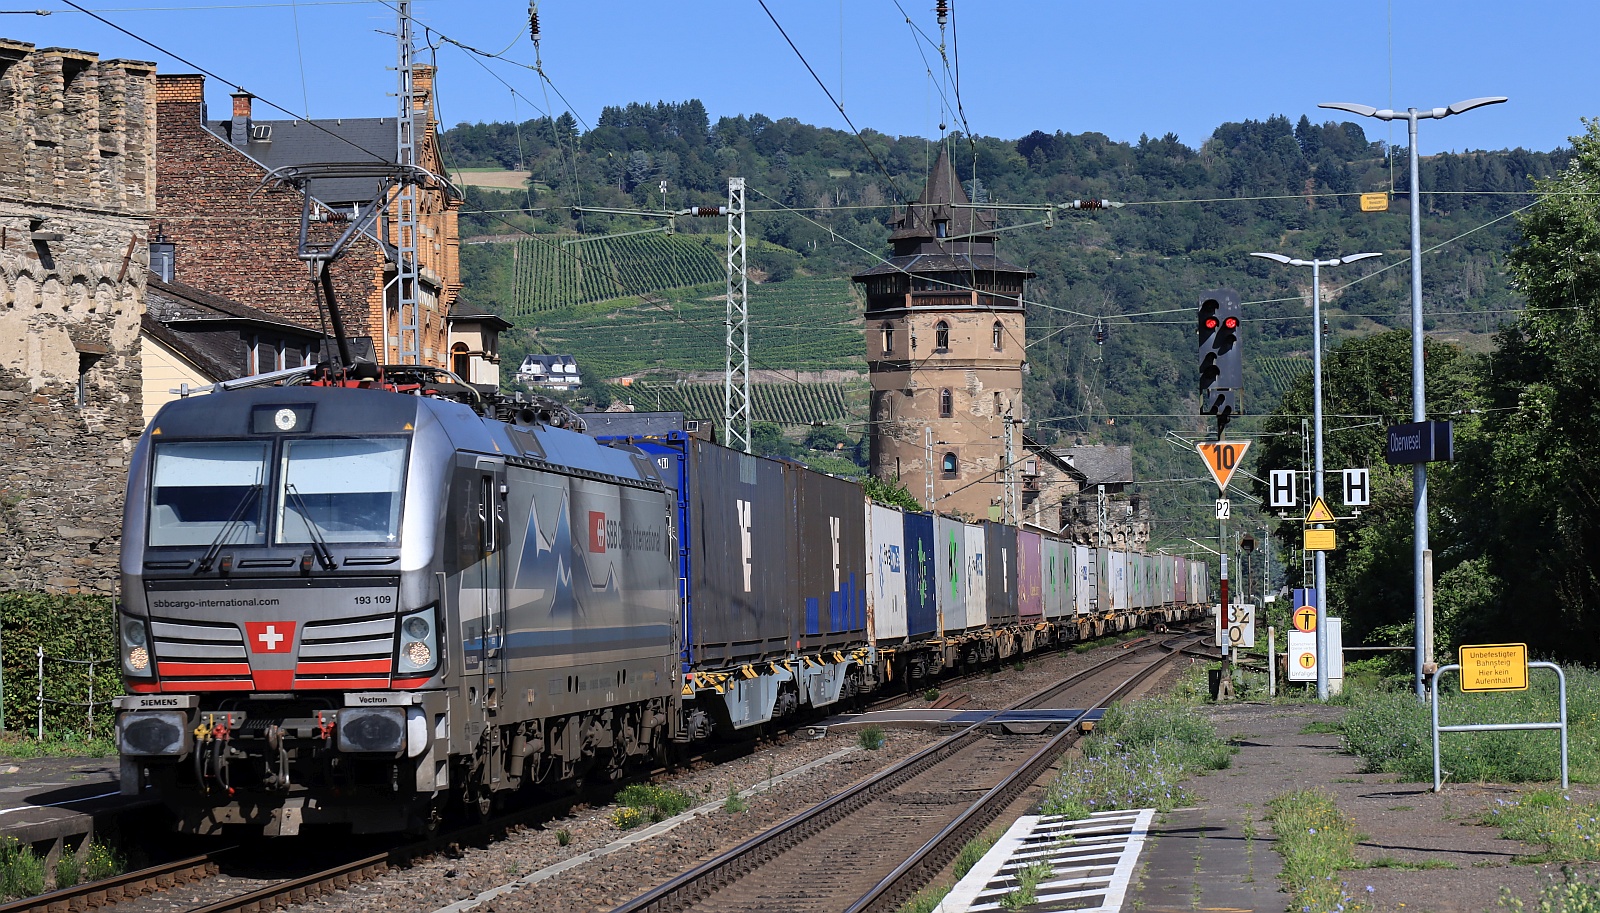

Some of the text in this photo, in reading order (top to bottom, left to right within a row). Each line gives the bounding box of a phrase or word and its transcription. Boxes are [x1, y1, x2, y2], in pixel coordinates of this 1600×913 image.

[1391, 430, 1420, 452] Oberwesel
[1213, 445, 1235, 470] 10
[1273, 473, 1293, 503] H
[1346, 472, 1366, 502] H
[1216, 502, 1230, 517] P2
[606, 519, 618, 549] SBB
[153, 598, 280, 610] sbbcargo-international.com
[354, 595, 391, 605] 193 109
[1470, 651, 1517, 659] Unbefestigter
[1476, 659, 1511, 667] Bahnsteig
[1475, 677, 1513, 685] Aufenthalt!
[140, 698, 178, 707] SIEMENS
[358, 696, 388, 704] Vectron
